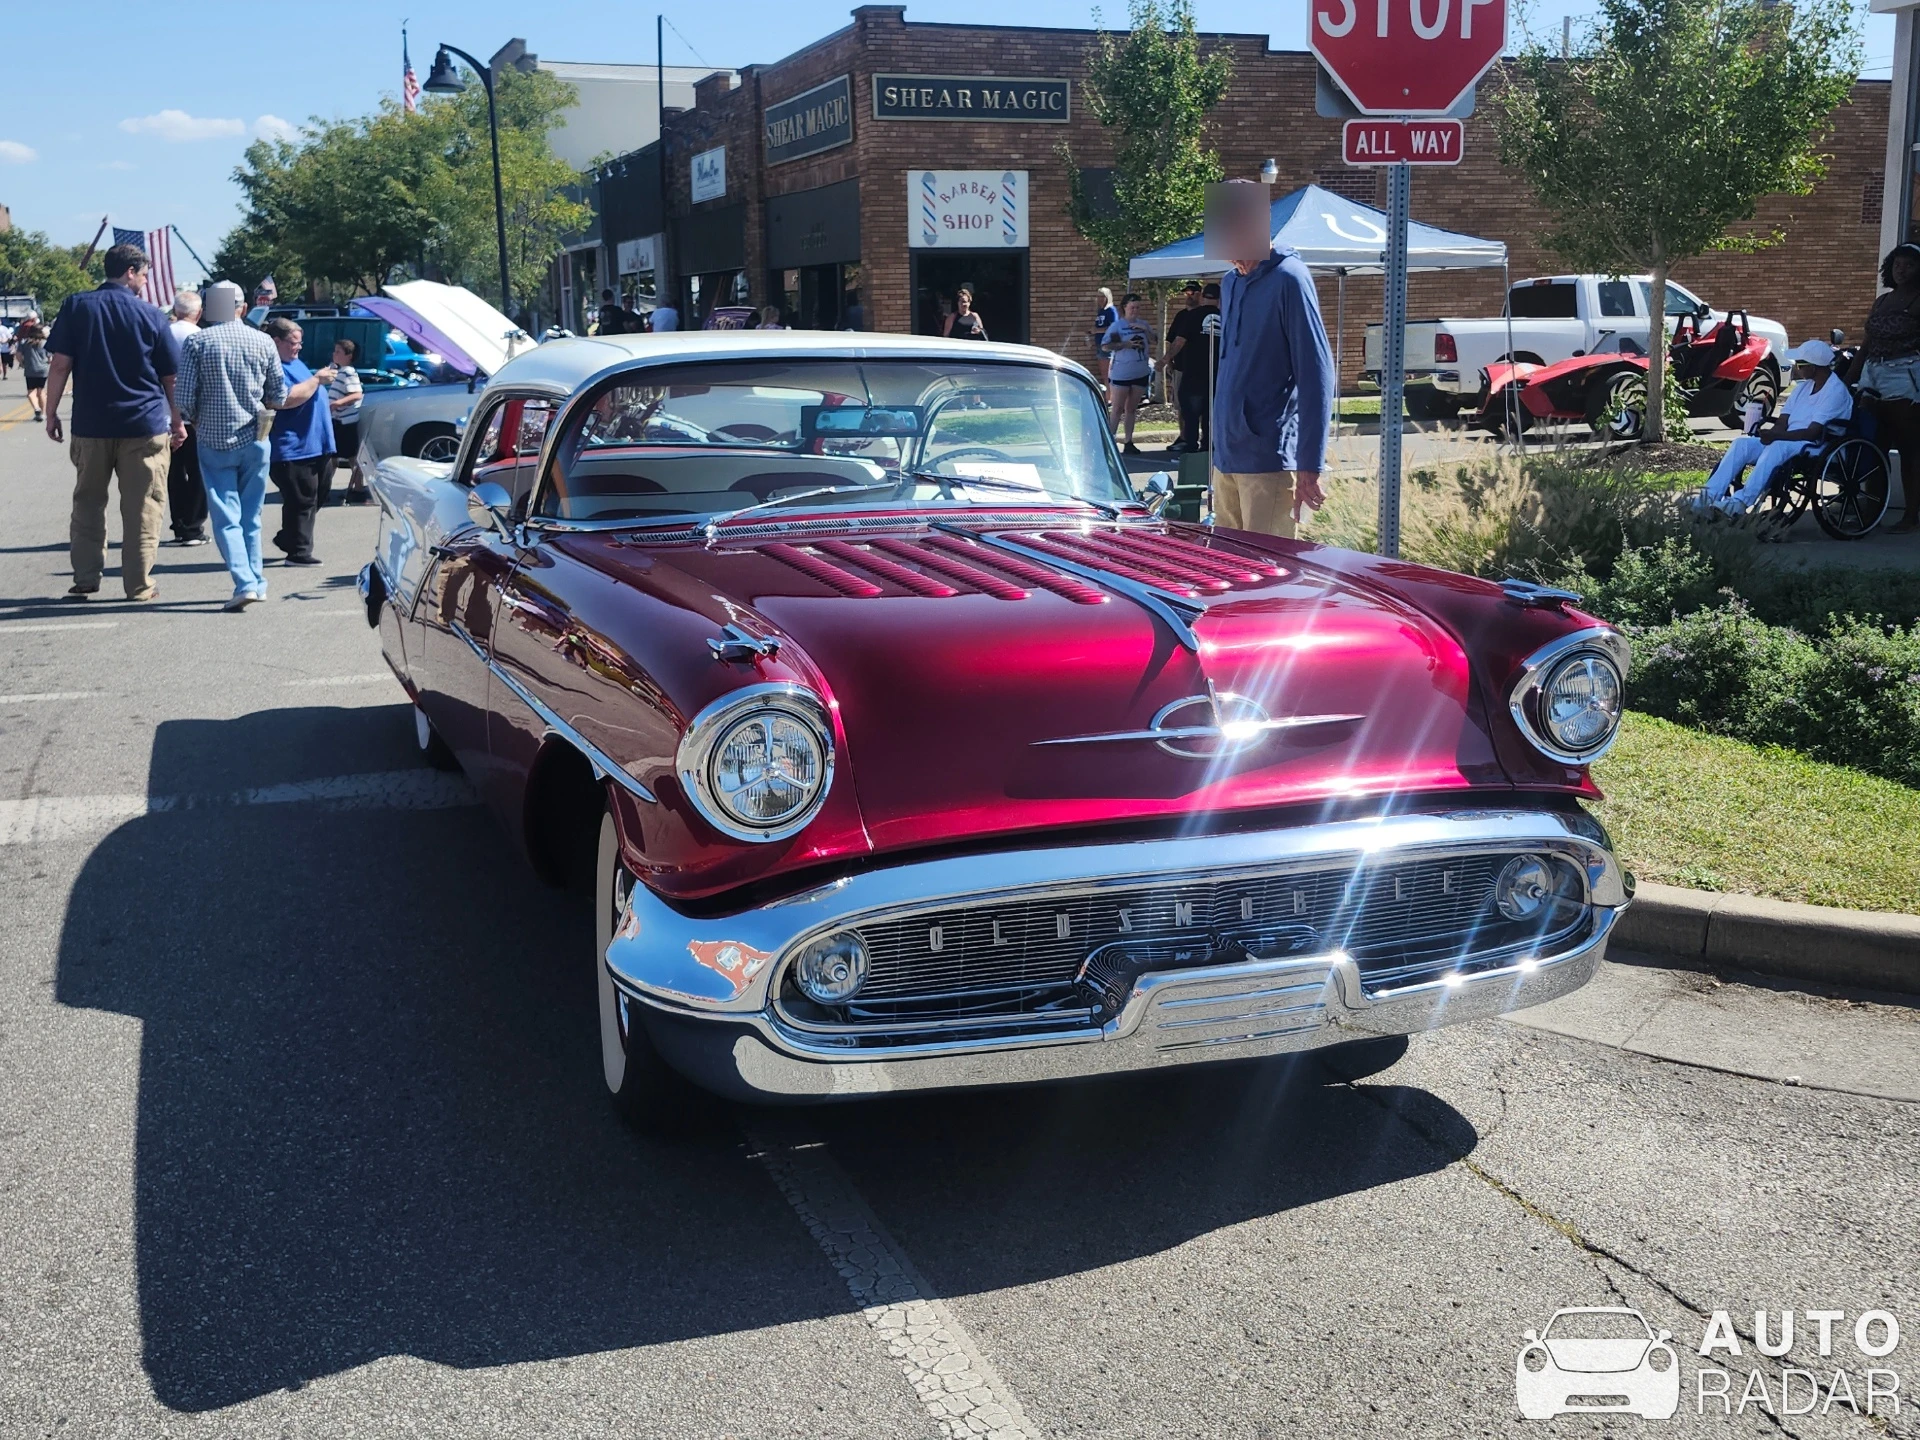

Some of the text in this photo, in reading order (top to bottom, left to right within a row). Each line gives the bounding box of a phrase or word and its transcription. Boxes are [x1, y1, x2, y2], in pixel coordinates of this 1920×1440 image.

[884, 87, 1063, 111] SHEAR MAGIC
[766, 96, 848, 149] SHEAR MAGIC
[1355, 131, 1452, 154] ALL WAY
[939, 181, 997, 205] BARBER
[942, 214, 994, 230] SHOP
[929, 871, 1455, 950] OLDSMOBILE
